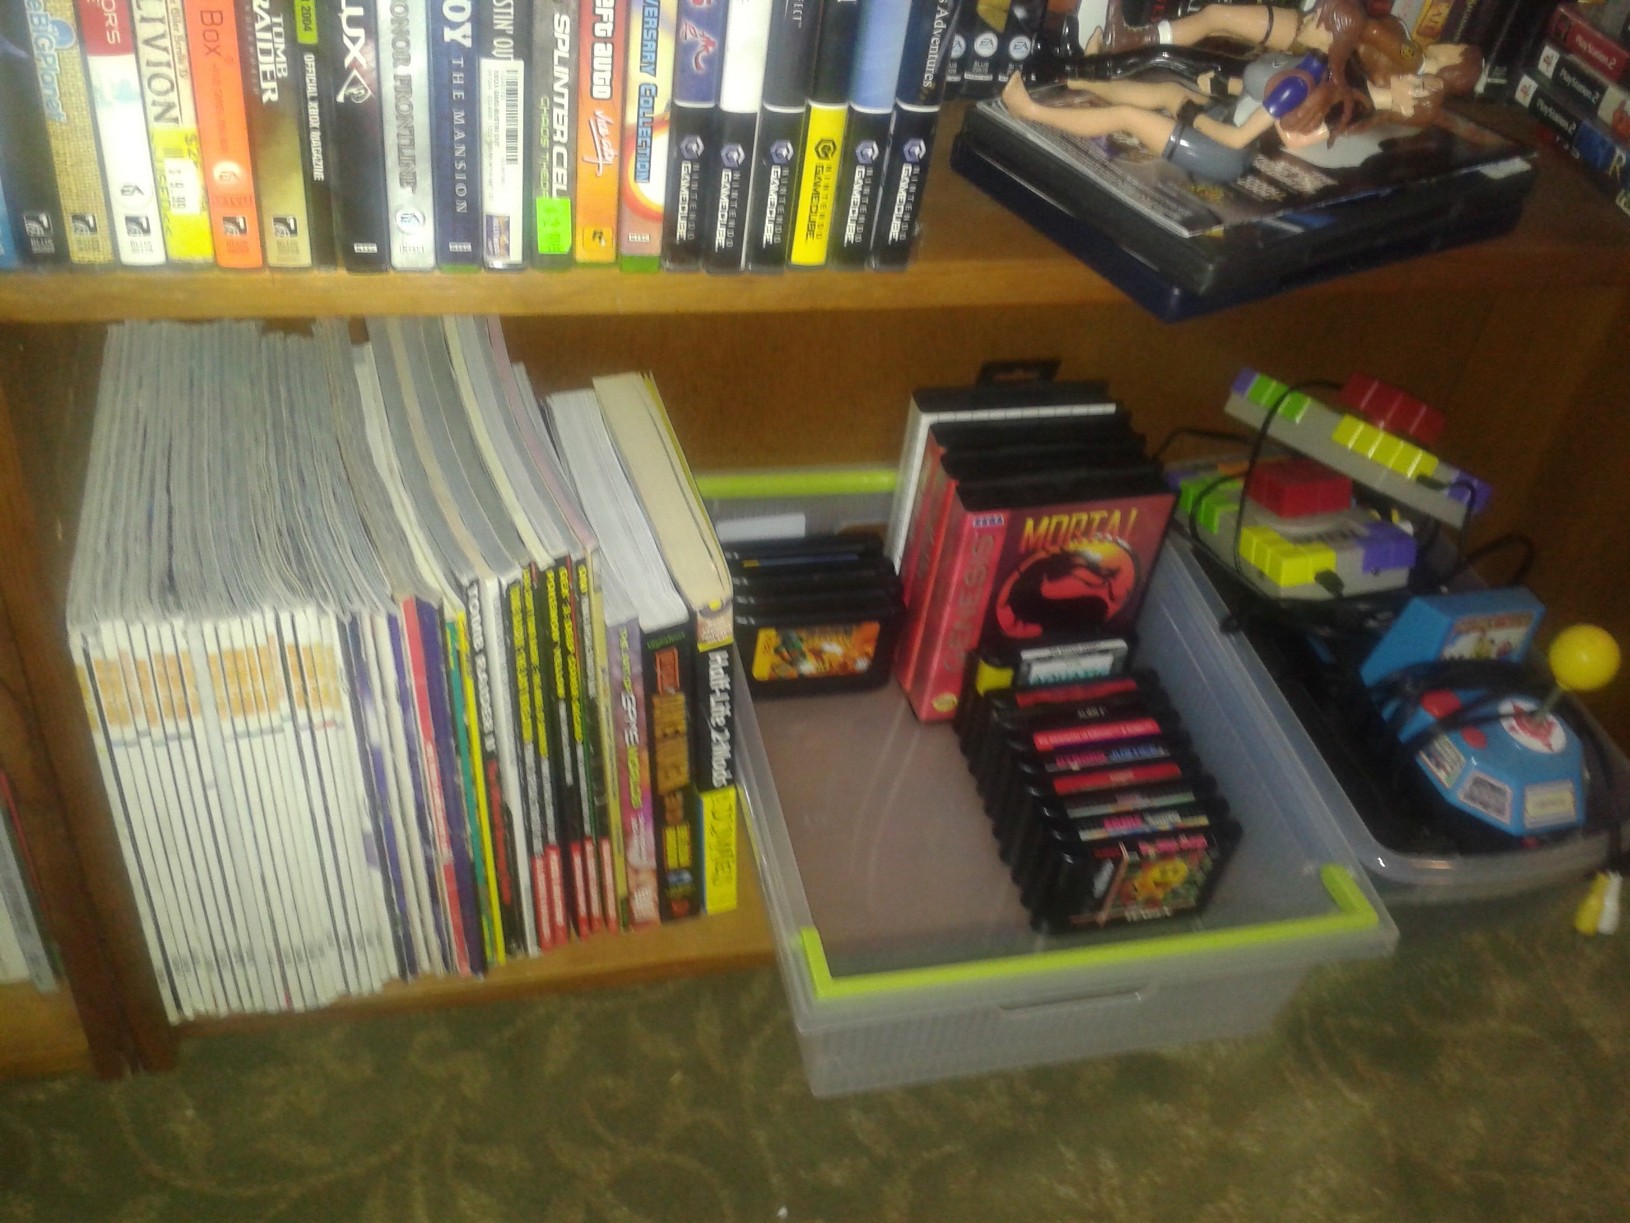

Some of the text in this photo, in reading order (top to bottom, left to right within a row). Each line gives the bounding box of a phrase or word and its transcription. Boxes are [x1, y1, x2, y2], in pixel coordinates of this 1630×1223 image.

[272, 14, 288, 78] TOMB
[304, 54, 318, 100] OFFICIAL
[451, 56, 464, 101] THE
[553, 13, 571, 143] SPLINTER
[922, 9, 950, 88] Adventures
[453, 108, 468, 214] MANSION
[540, 96, 550, 147] CHAOS
[634, 83, 659, 184] COLLECTION
[552, 145, 569, 198] CEL
[676, 160, 693, 244] GAMECUBE
[714, 168, 732, 252] GAMECUBE
[762, 164, 782, 248] GAMECUBE
[804, 163, 824, 241] GAMECUBE
[843, 164, 866, 248] GAMECUBE
[888, 162, 912, 244] GAMECUBE
[467, 583, 485, 654] TOMB
[475, 653, 494, 734] RAIDER
[708, 650, 731, 727] Half-Life
